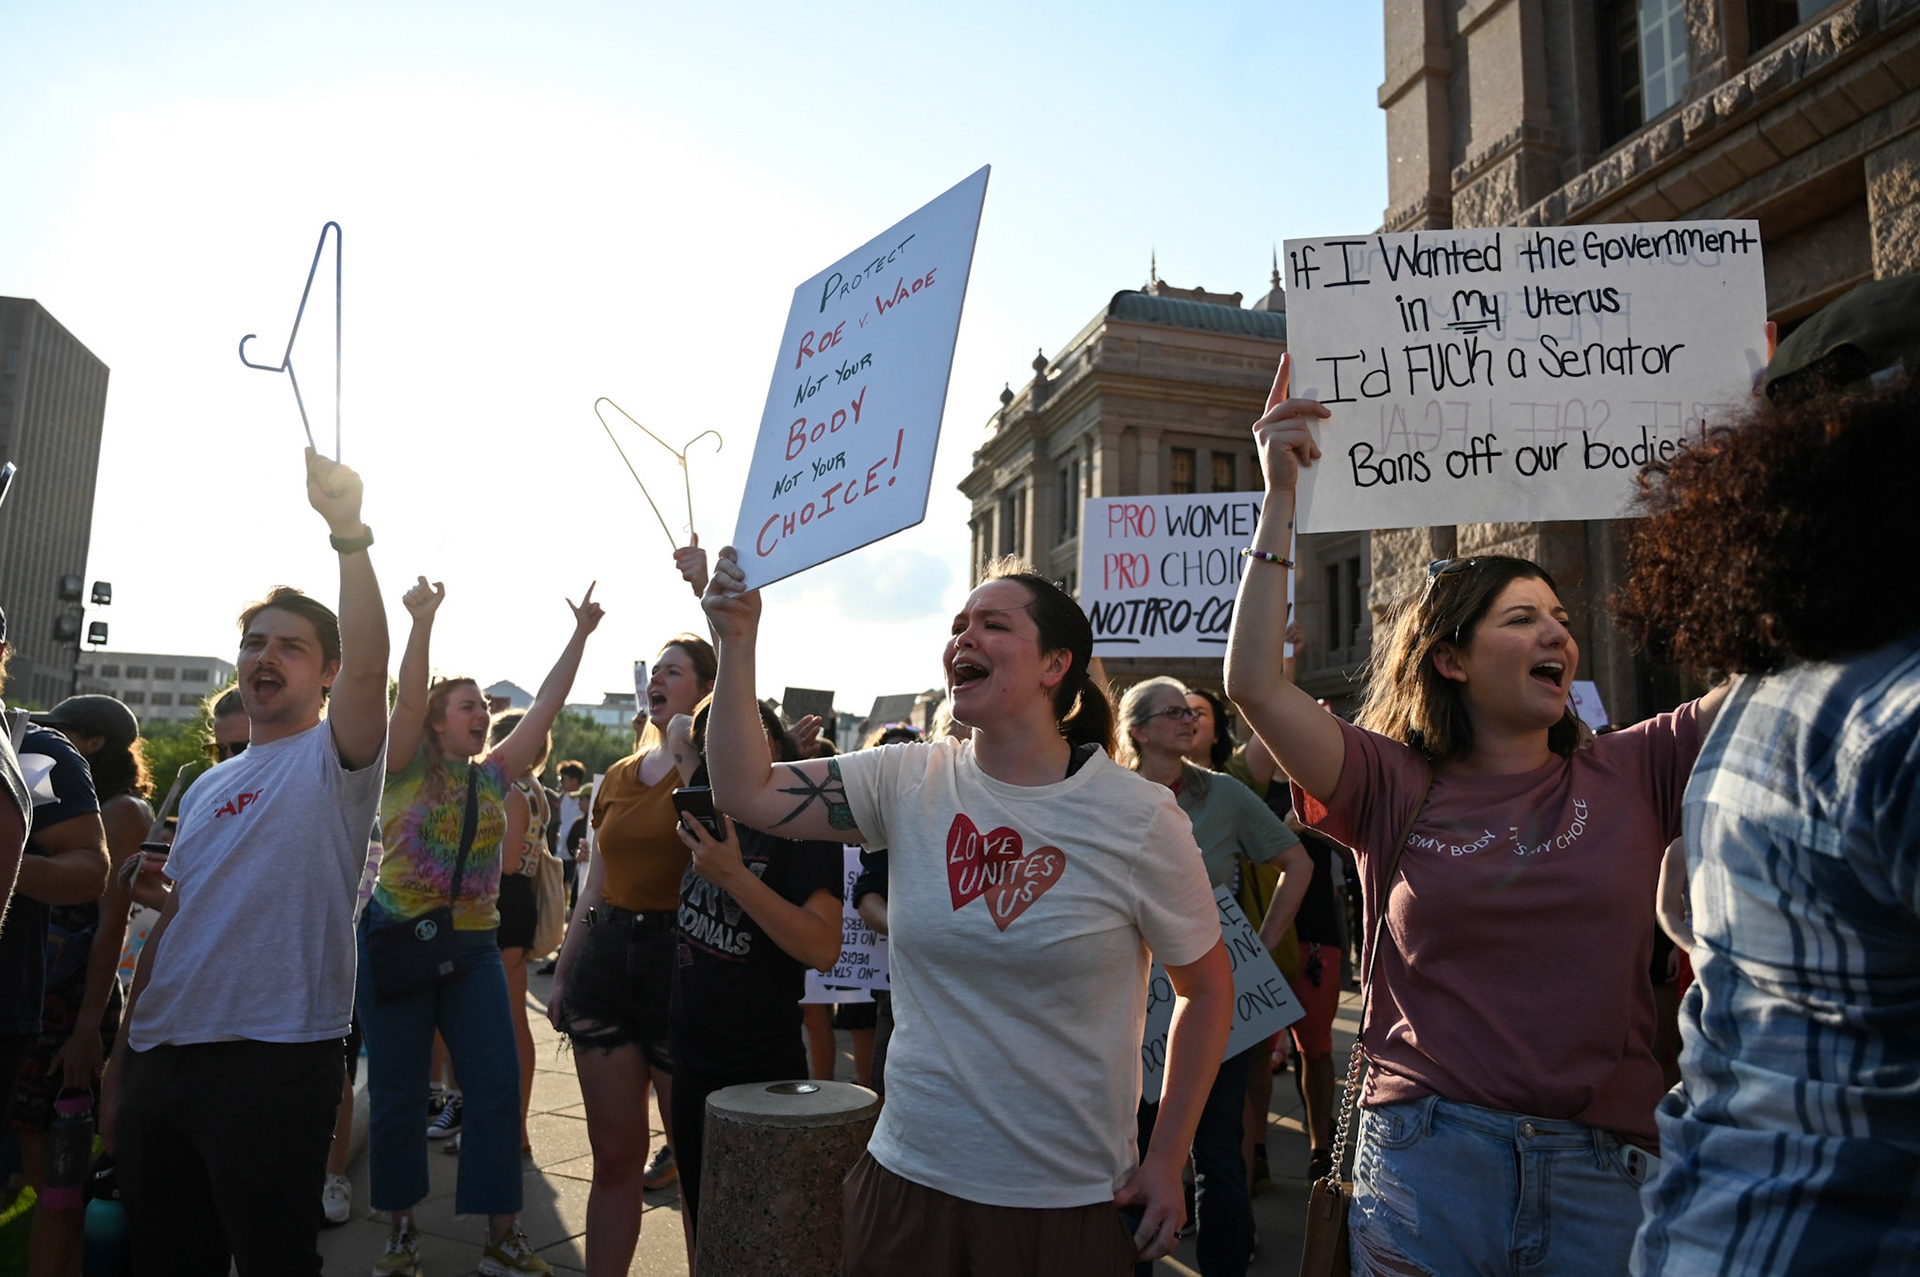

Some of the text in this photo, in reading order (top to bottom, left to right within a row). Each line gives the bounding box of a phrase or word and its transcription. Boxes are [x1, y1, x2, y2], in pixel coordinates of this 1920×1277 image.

[820, 234, 915, 313] PROTECT
[1324, 241, 1370, 287] I
[1378, 233, 1501, 281] Wanted
[1520, 230, 1576, 273] the
[1583, 226, 1760, 268] Government
[796, 321, 846, 370] ROE
[875, 267, 937, 316] WADE
[1396, 295, 1429, 332] in
[1524, 286, 1620, 318] Uterus
[835, 353, 872, 386] YOUR
[1316, 348, 1391, 404] I'd
[1508, 348, 1526, 378] a
[1539, 335, 1685, 378] Senator
[785, 386, 866, 461] BODY
[772, 451, 846, 499] NOT YOUR
[1349, 442, 1431, 487] Bans
[1446, 434, 1502, 478] off
[1516, 443, 1567, 476] our
[757, 428, 904, 557] CHOICE!
[1108, 504, 1155, 538] PRO
[1104, 547, 1243, 590] PRO CHOI
[950, 827, 1016, 865] LOVE
[1417, 838, 1446, 852] MY
[1451, 829, 1496, 856] BODY
[1556, 798, 1589, 850] CHOICE
[958, 854, 1056, 895] UNITES
[996, 881, 1038, 918] US
[1237, 978, 1287, 1021] ONE
